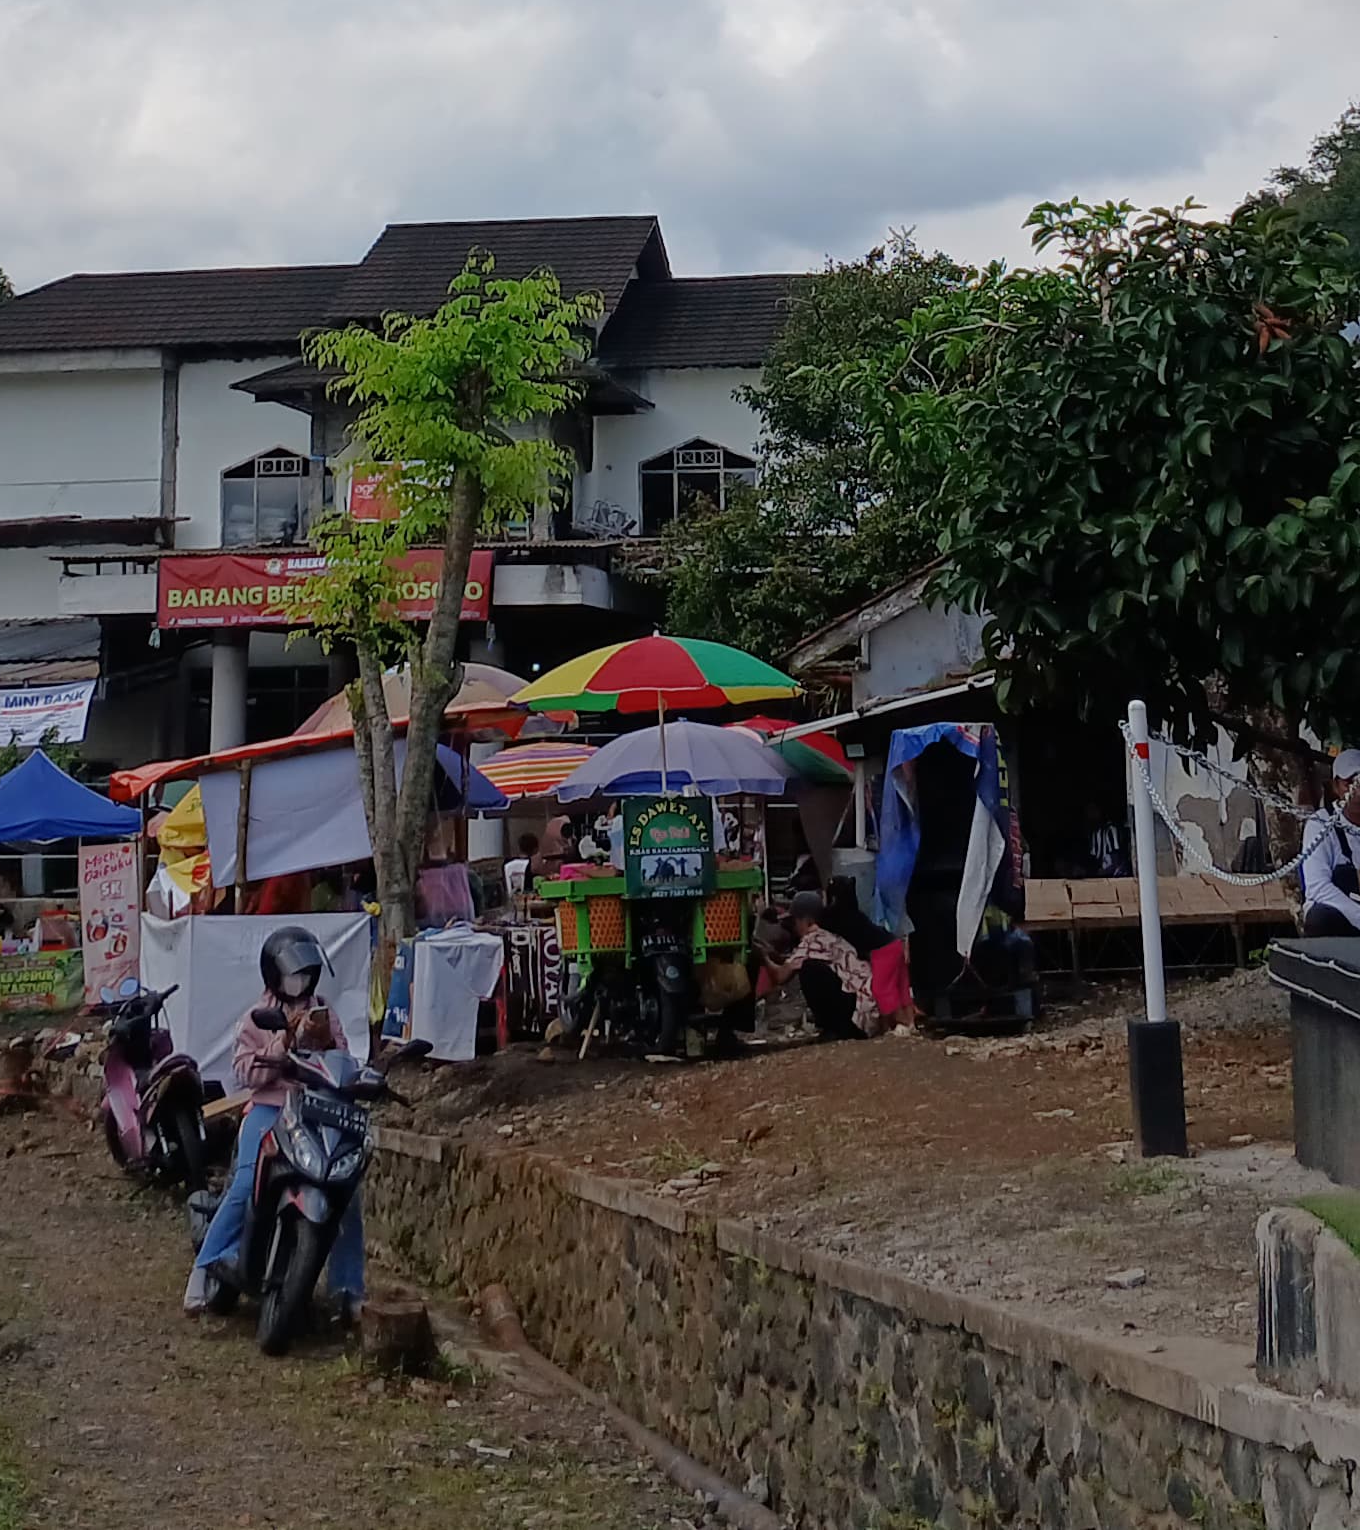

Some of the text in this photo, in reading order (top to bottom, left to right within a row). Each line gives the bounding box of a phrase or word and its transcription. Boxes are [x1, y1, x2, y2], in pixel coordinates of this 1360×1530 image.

[168, 586, 264, 608] BARANG
[4, 695, 41, 709] MINI
[43, 690, 85, 706] BANK
[638, 800, 688, 827] DAWET
